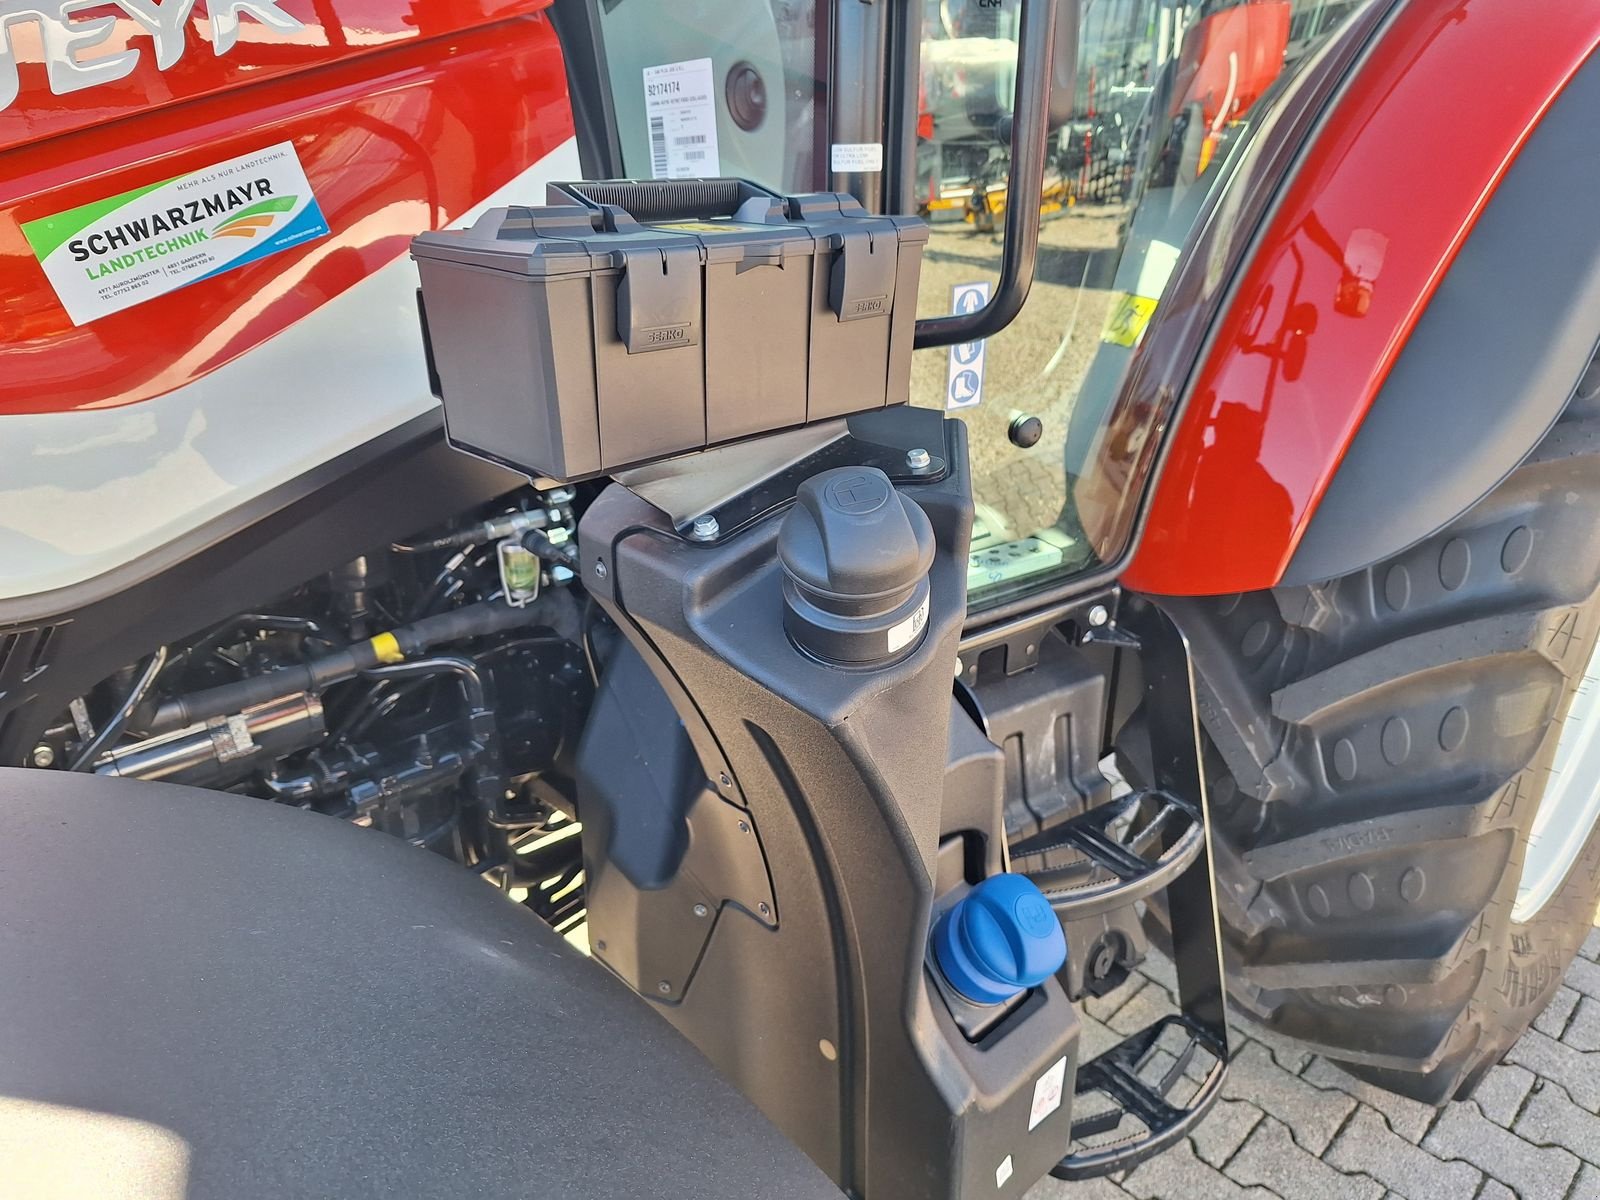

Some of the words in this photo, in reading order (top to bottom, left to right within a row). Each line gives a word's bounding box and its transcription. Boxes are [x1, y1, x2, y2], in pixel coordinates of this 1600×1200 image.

[176, 180, 200, 191] MEHR
[201, 174, 216, 185] ALS
[217, 168, 234, 179] NUR
[68, 178, 274, 262] SCHWARZMAYR
[85, 228, 209, 280] LANDTECHNIK
[180, 252, 207, 265] GAMPERN
[98, 286, 112, 295] 4971
[112, 269, 160, 289] AUROLZMÜNSTER
[101, 293, 114, 301] TEL.
